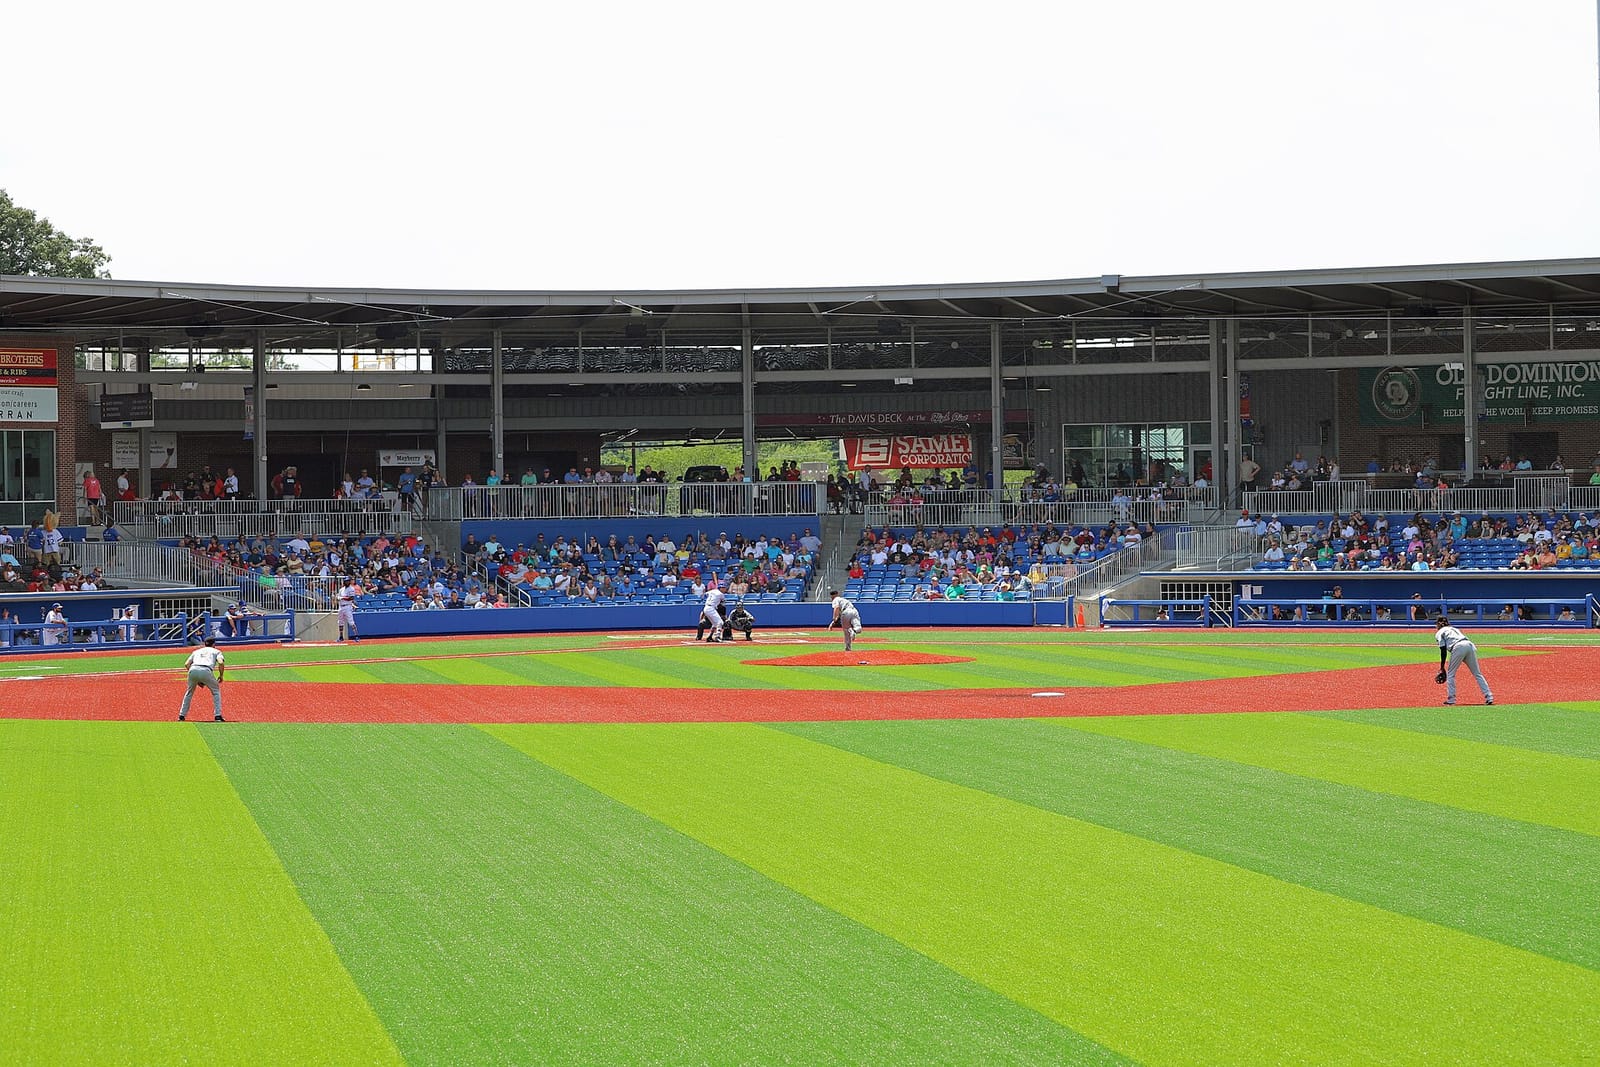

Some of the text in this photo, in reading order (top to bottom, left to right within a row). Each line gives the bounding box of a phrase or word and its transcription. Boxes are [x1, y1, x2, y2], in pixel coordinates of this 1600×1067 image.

[1, 355, 43, 363] BROTHERS
[1435, 363, 1464, 385] OL
[1517, 385, 1551, 400] LINE,
[1556, 384, 1585, 398] INC.
[1499, 408, 1527, 416] WORL
[1555, 405, 1599, 415] PROMISES
[830, 415, 846, 424] The
[847, 414, 876, 424] DAVIS
[878, 413, 903, 423] DECK
[900, 453, 972, 465] CORPORATIO
